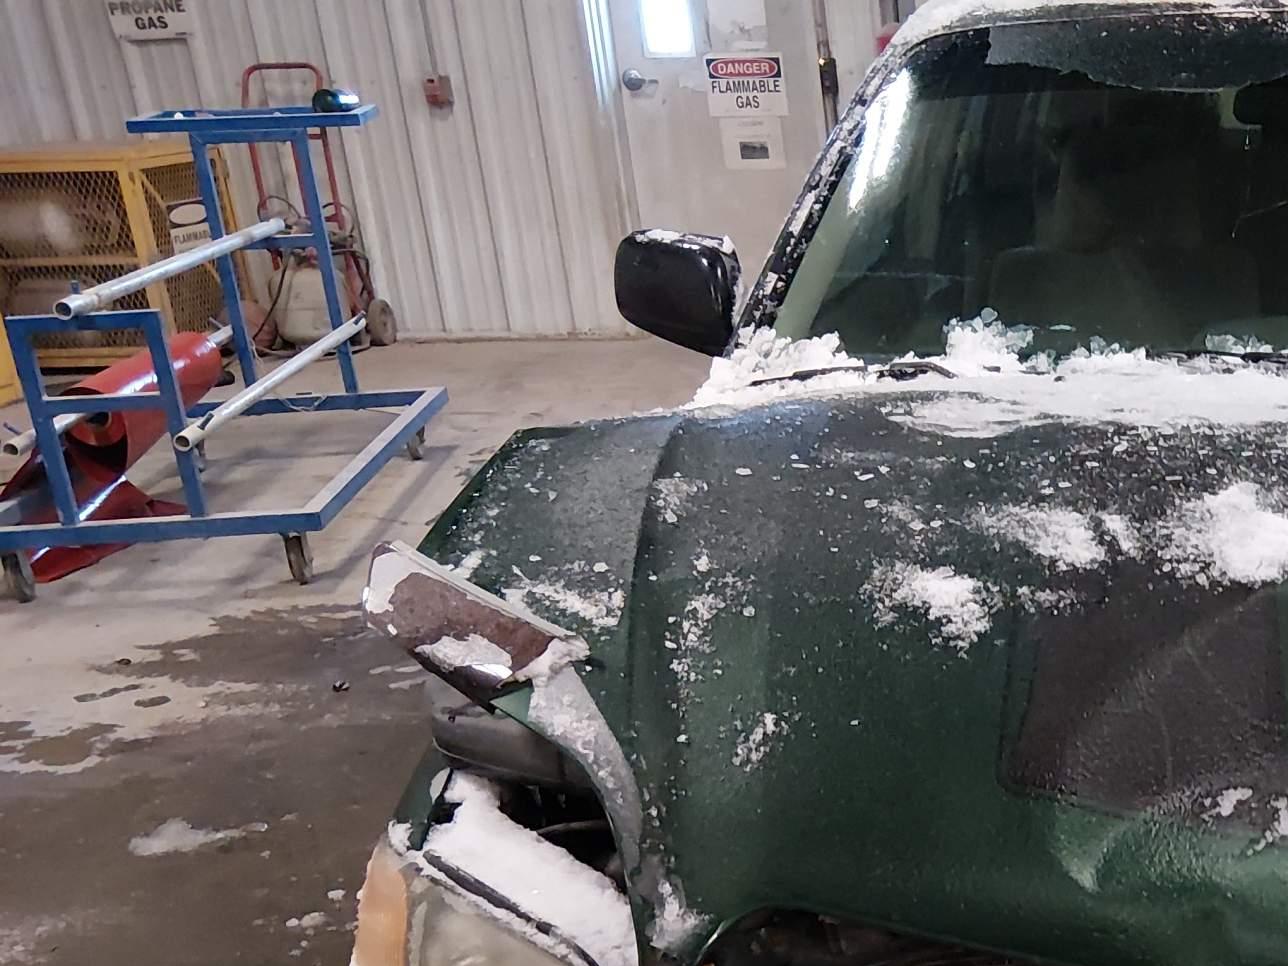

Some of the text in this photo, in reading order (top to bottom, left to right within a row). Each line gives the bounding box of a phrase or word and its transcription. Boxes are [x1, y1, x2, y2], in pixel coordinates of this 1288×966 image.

[108, 0, 186, 16] PROPANE
[135, 16, 169, 31] GAS
[718, 62, 770, 75] DANGER
[711, 79, 782, 94] FLAMMABLE
[736, 95, 760, 109] GAS
